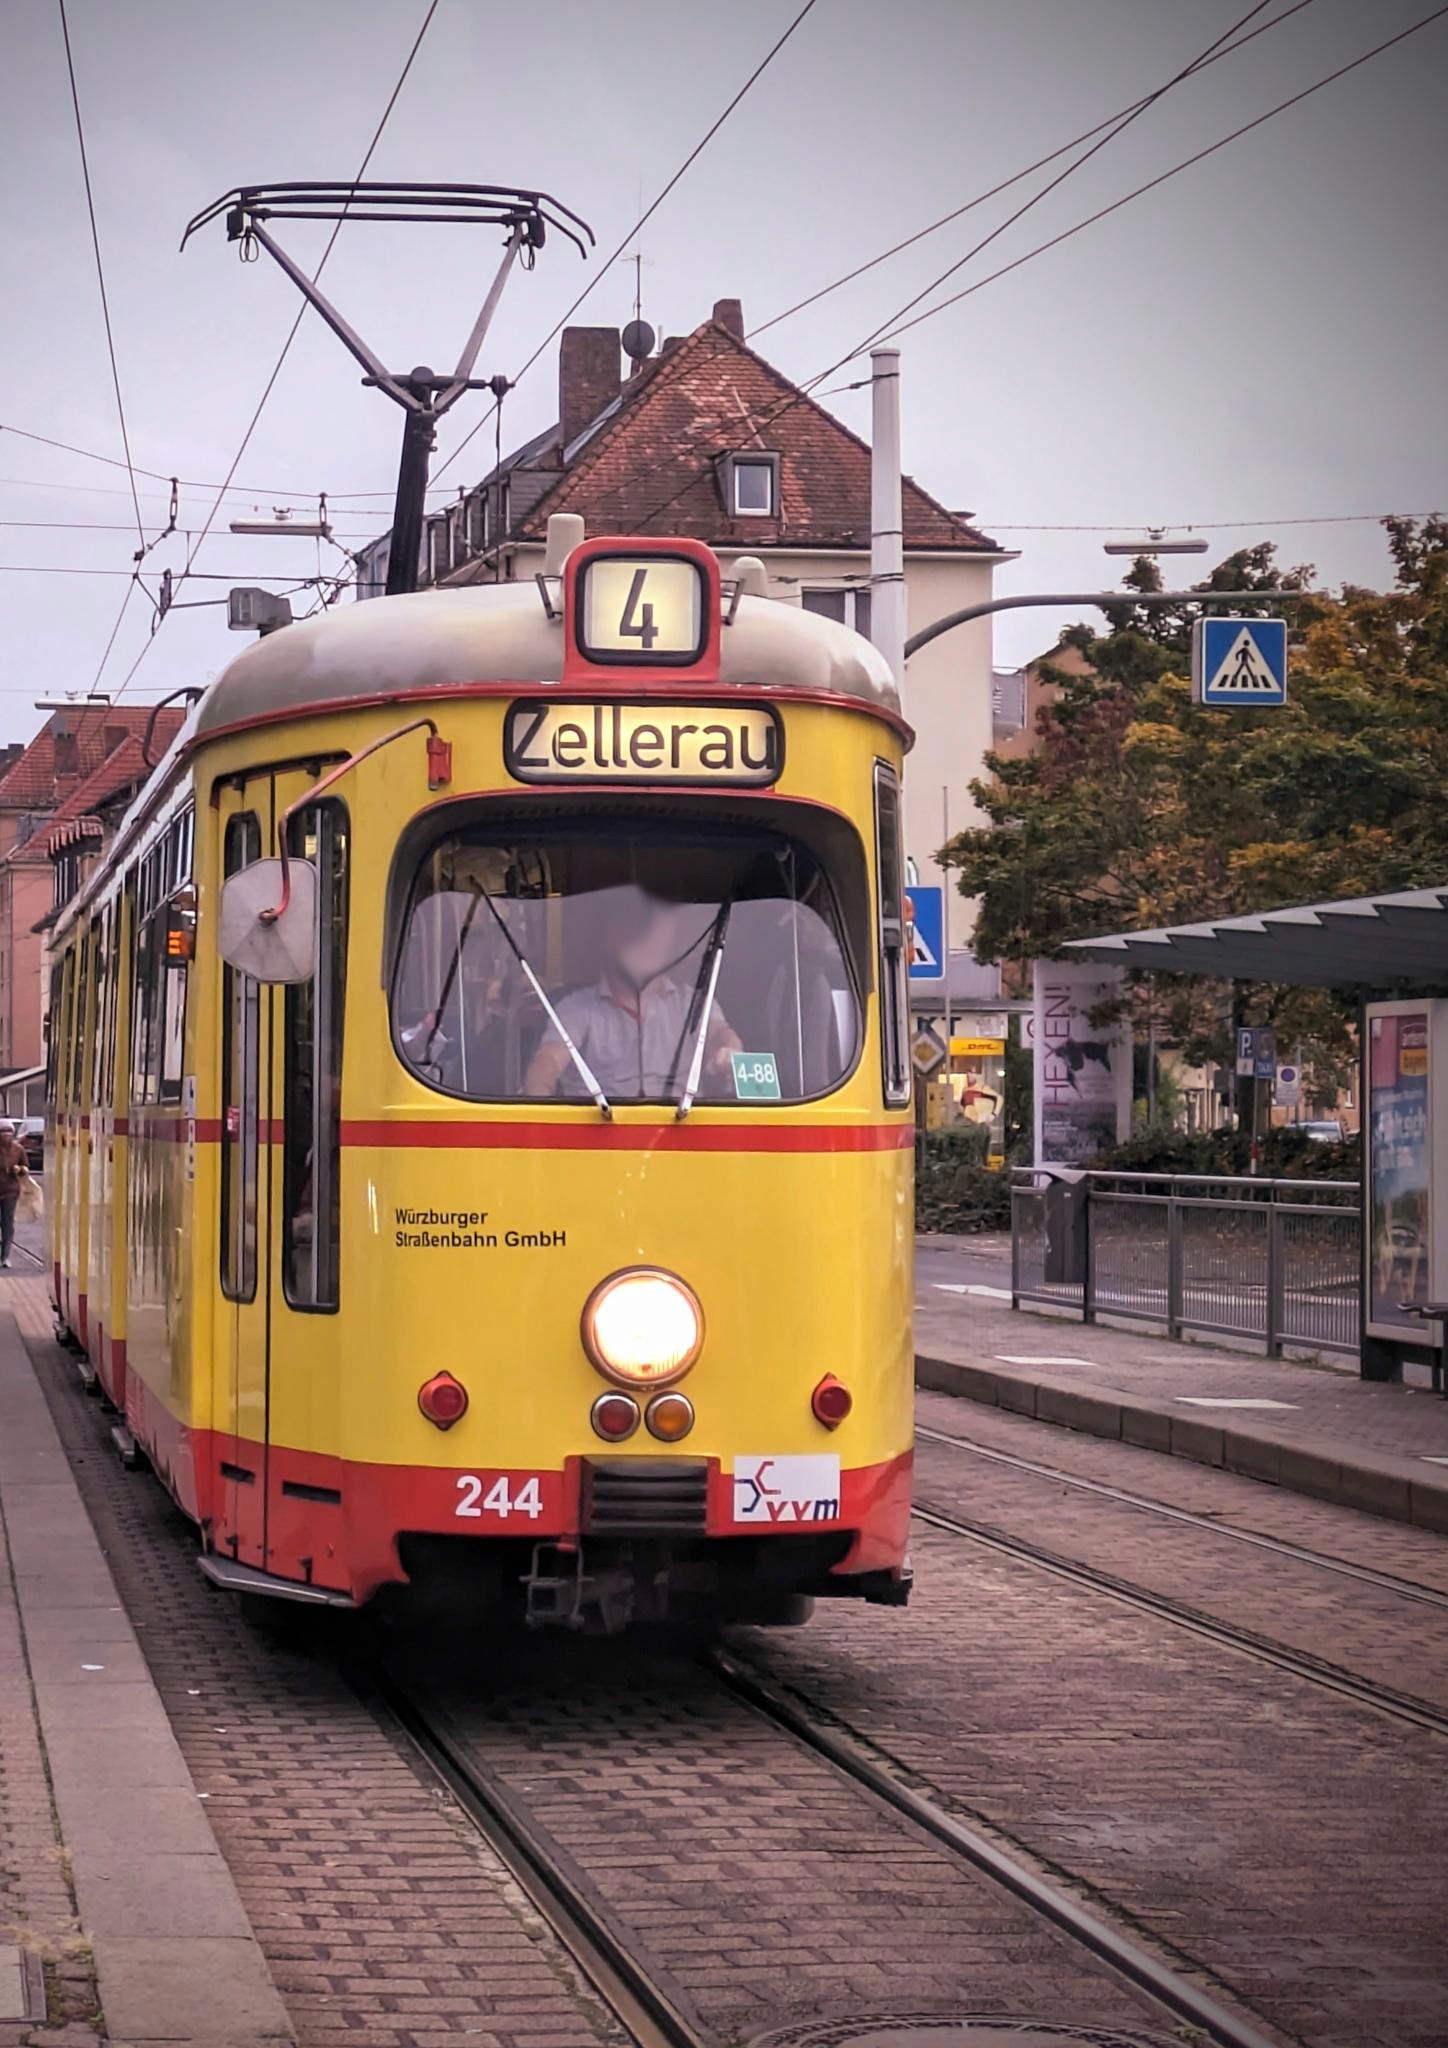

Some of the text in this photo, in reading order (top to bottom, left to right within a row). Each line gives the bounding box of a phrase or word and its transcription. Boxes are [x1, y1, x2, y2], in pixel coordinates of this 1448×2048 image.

[619, 569, 658, 648] 4
[513, 704, 775, 770] Zellerau
[1044, 987, 1070, 1107] HEXEN!
[738, 1062, 775, 1083] 4-88
[396, 1208, 488, 1228] Würzburger
[396, 1230, 566, 1247] Straßenbahn GmbH
[456, 1475, 543, 1519] 244
[767, 1499, 838, 1521] vvm
